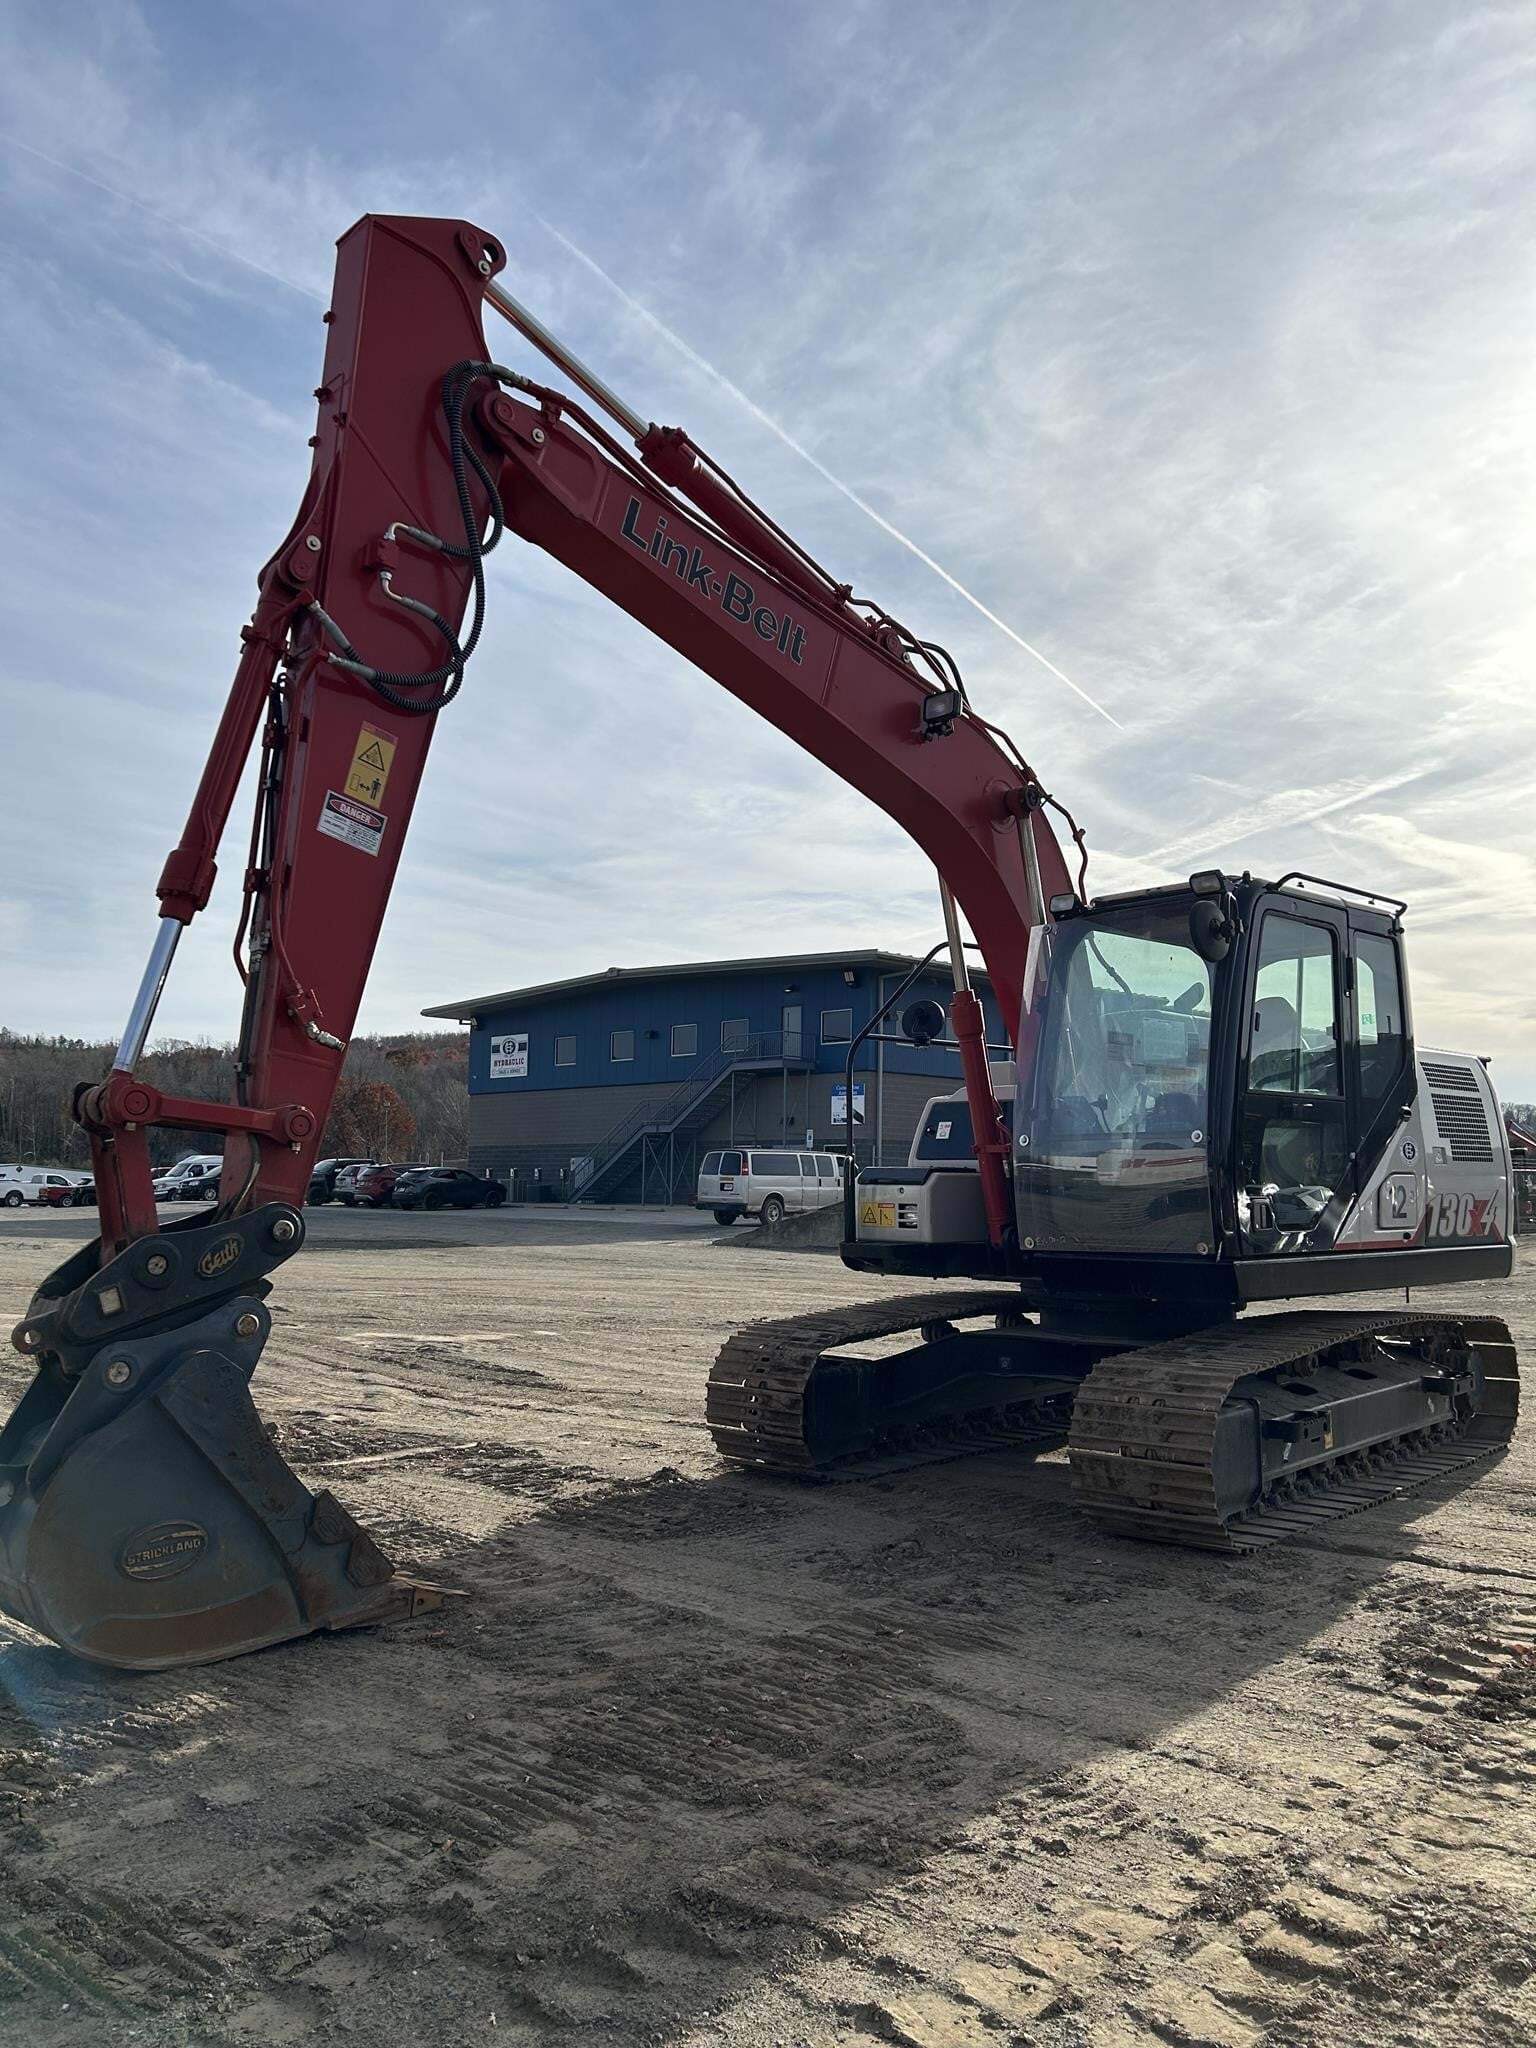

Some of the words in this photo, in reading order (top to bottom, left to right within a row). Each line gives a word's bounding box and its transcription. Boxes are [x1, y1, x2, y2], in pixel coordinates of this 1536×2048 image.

[621, 495, 806, 665] Link-Belt
[339, 802, 371, 824] DANGER
[127, 1538, 201, 1565] STRICKLAND
